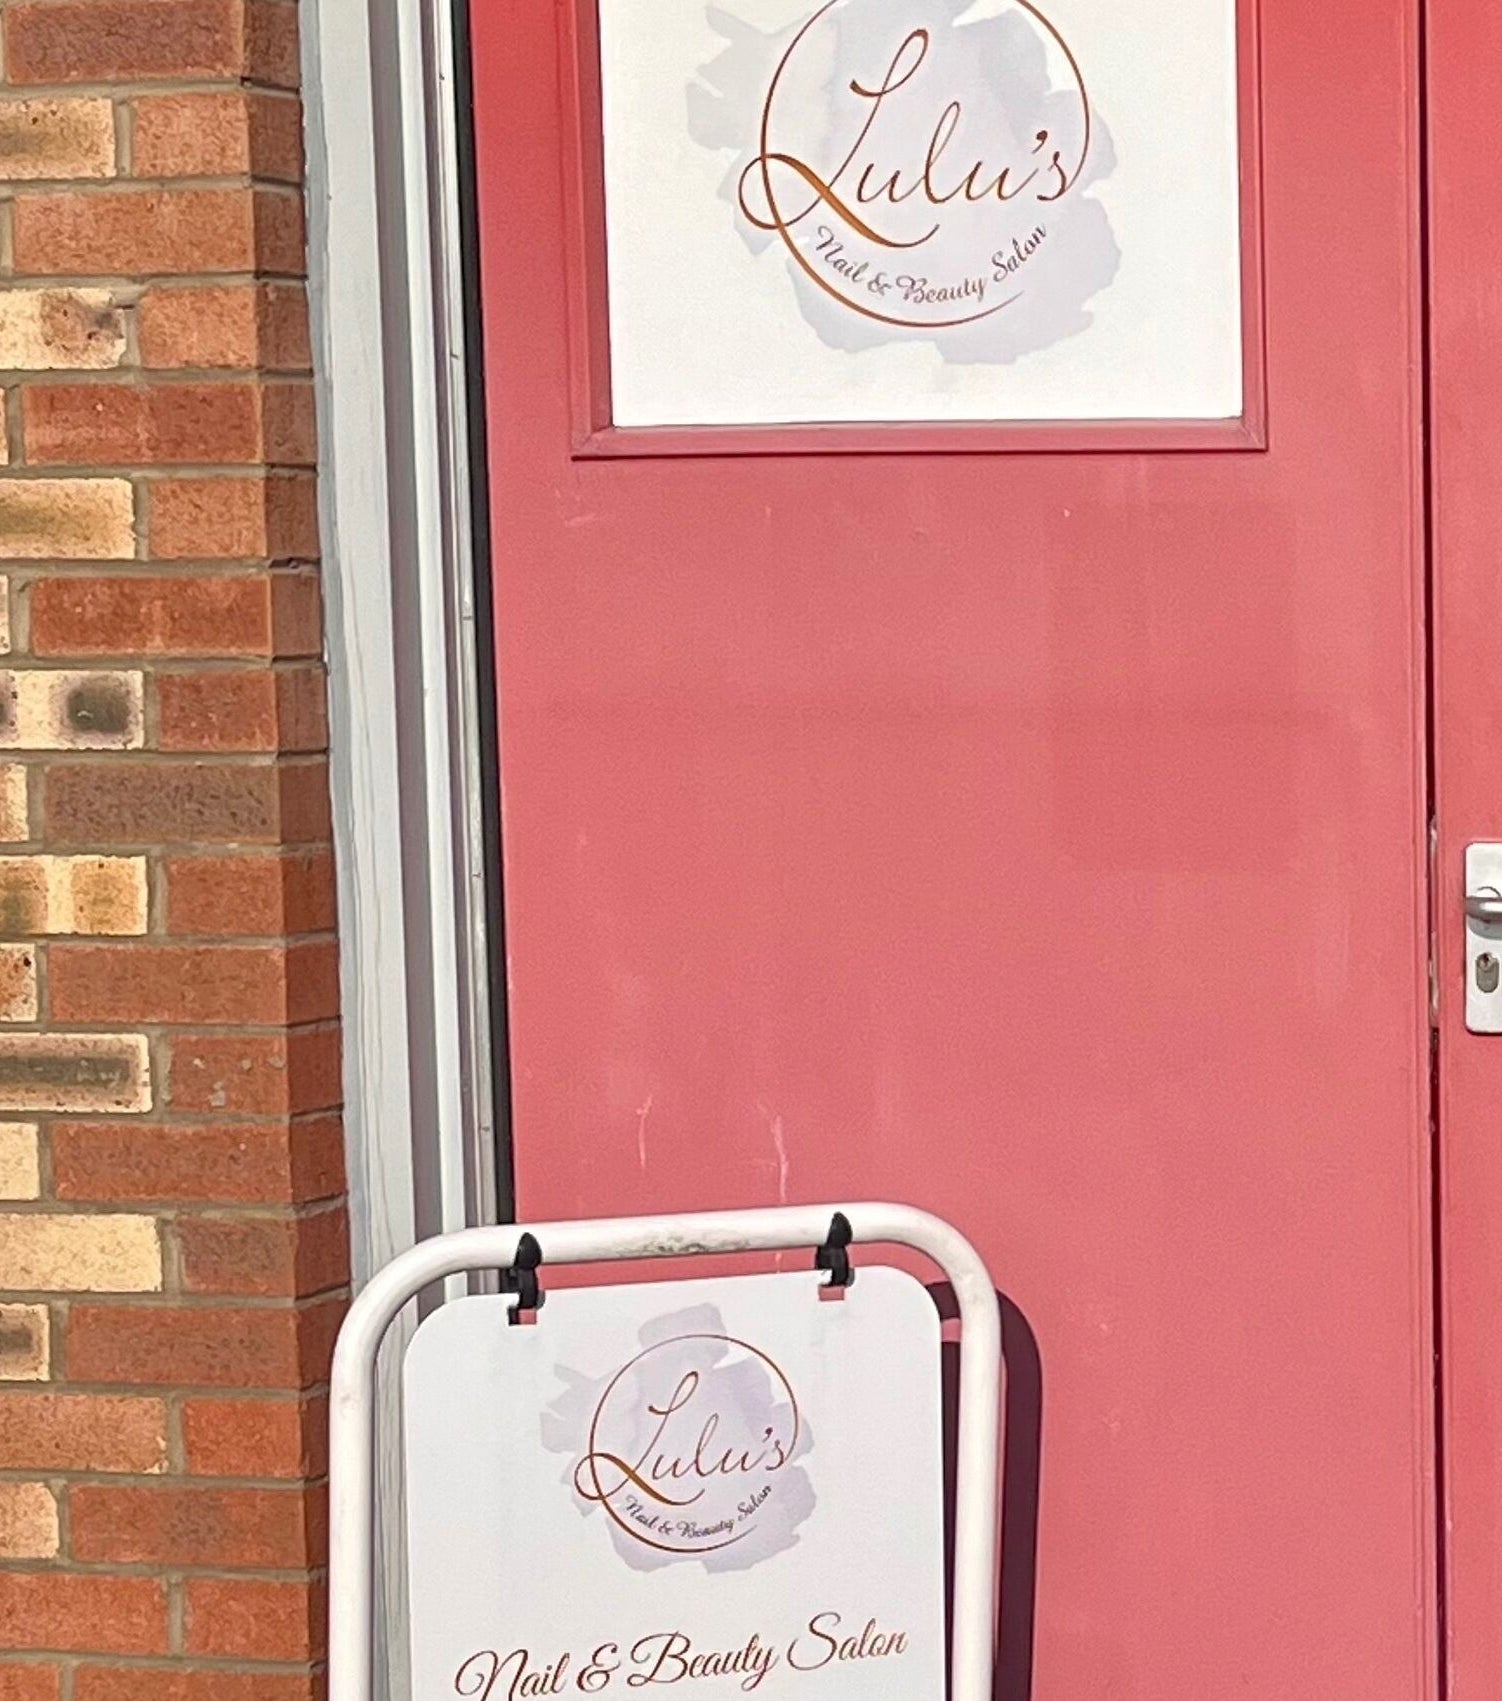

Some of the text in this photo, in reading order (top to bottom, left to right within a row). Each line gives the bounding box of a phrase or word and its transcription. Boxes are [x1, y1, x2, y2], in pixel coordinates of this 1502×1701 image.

[738, 29, 1072, 248] Lulu's
[816, 222, 1048, 304] Nail & Beauty Salon
[574, 1371, 785, 1506] Lulu's
[454, 1611, 909, 1701] Nail & Beauty Salon
